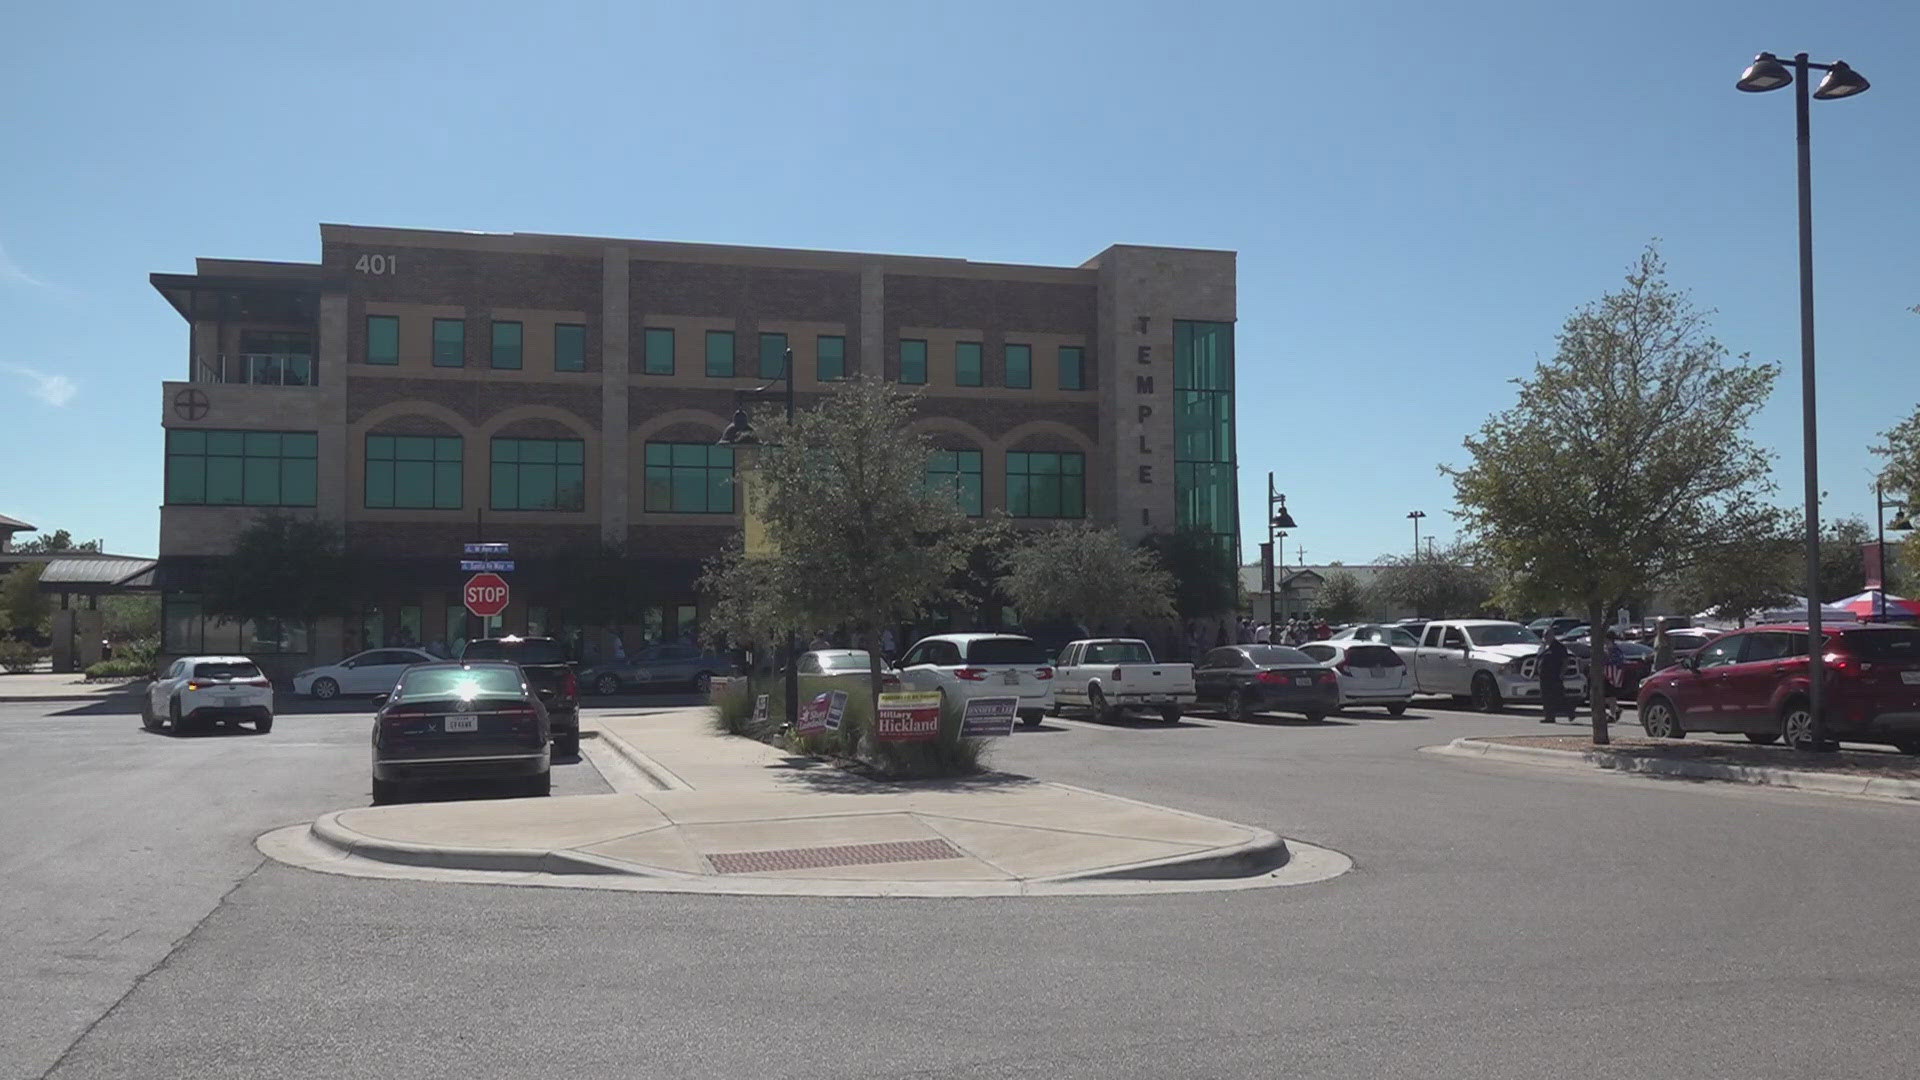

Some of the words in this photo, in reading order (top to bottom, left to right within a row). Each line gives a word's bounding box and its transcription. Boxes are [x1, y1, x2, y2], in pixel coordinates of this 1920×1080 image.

[354, 254, 396, 275] 401
[1136, 316, 1154, 483] TEMPLE
[467, 586, 506, 603] STOP
[879, 716, 938, 732] Hickland
[880, 711, 912, 720] Hillary
